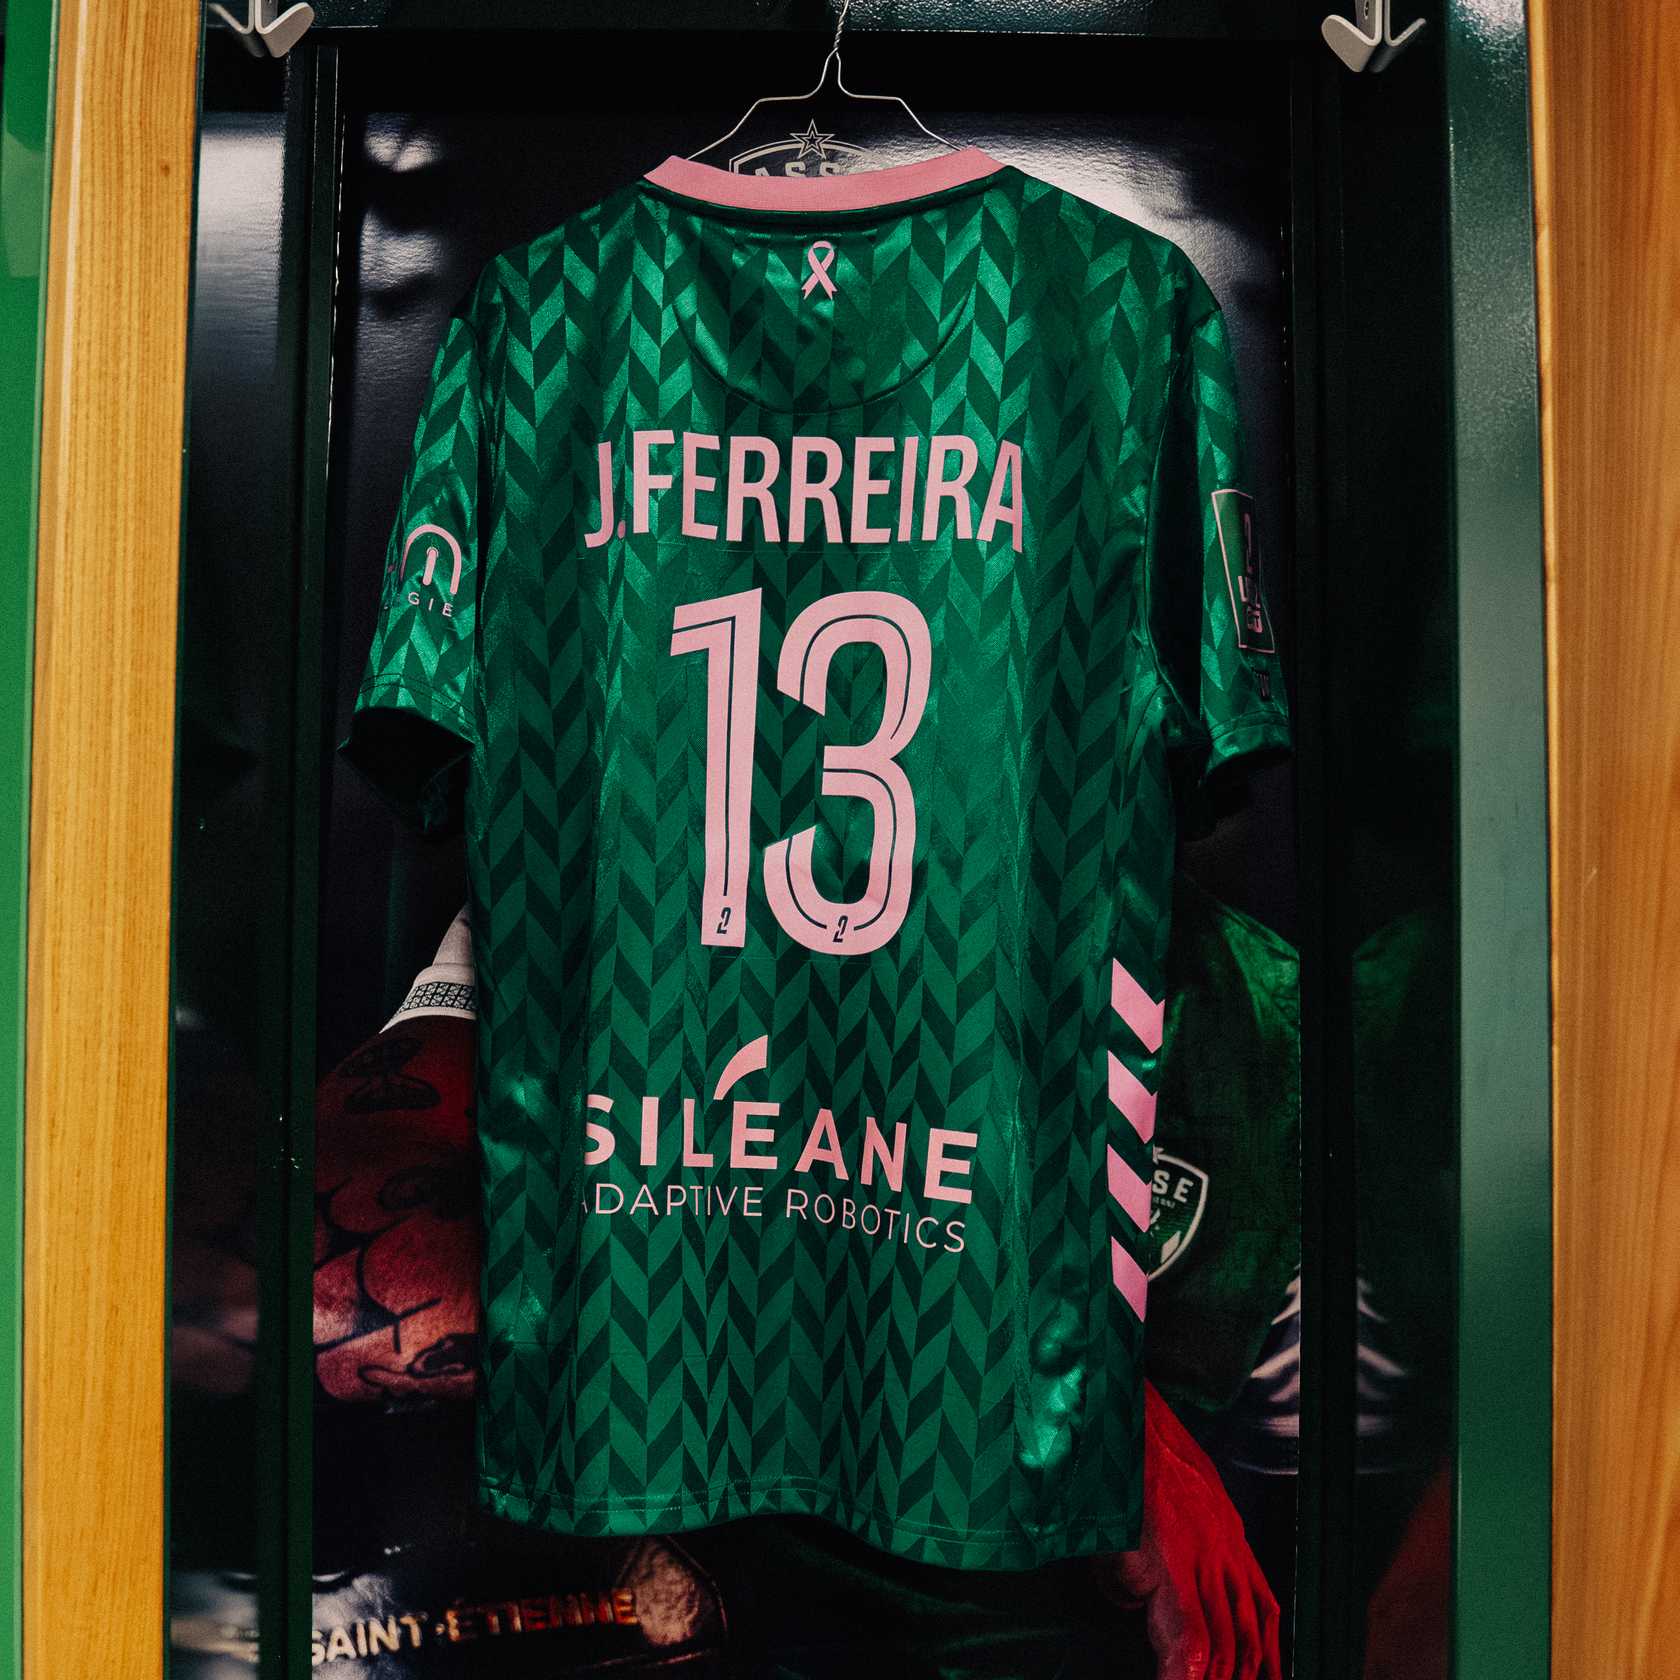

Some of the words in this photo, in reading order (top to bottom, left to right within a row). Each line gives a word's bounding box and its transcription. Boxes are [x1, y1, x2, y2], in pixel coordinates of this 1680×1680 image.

[584, 430, 1022, 554] J.FERREIRA
[670, 587, 932, 957] 13
[582, 1182, 764, 1218] DAPTIVE
[786, 1188, 967, 1254] ROBOTICS
